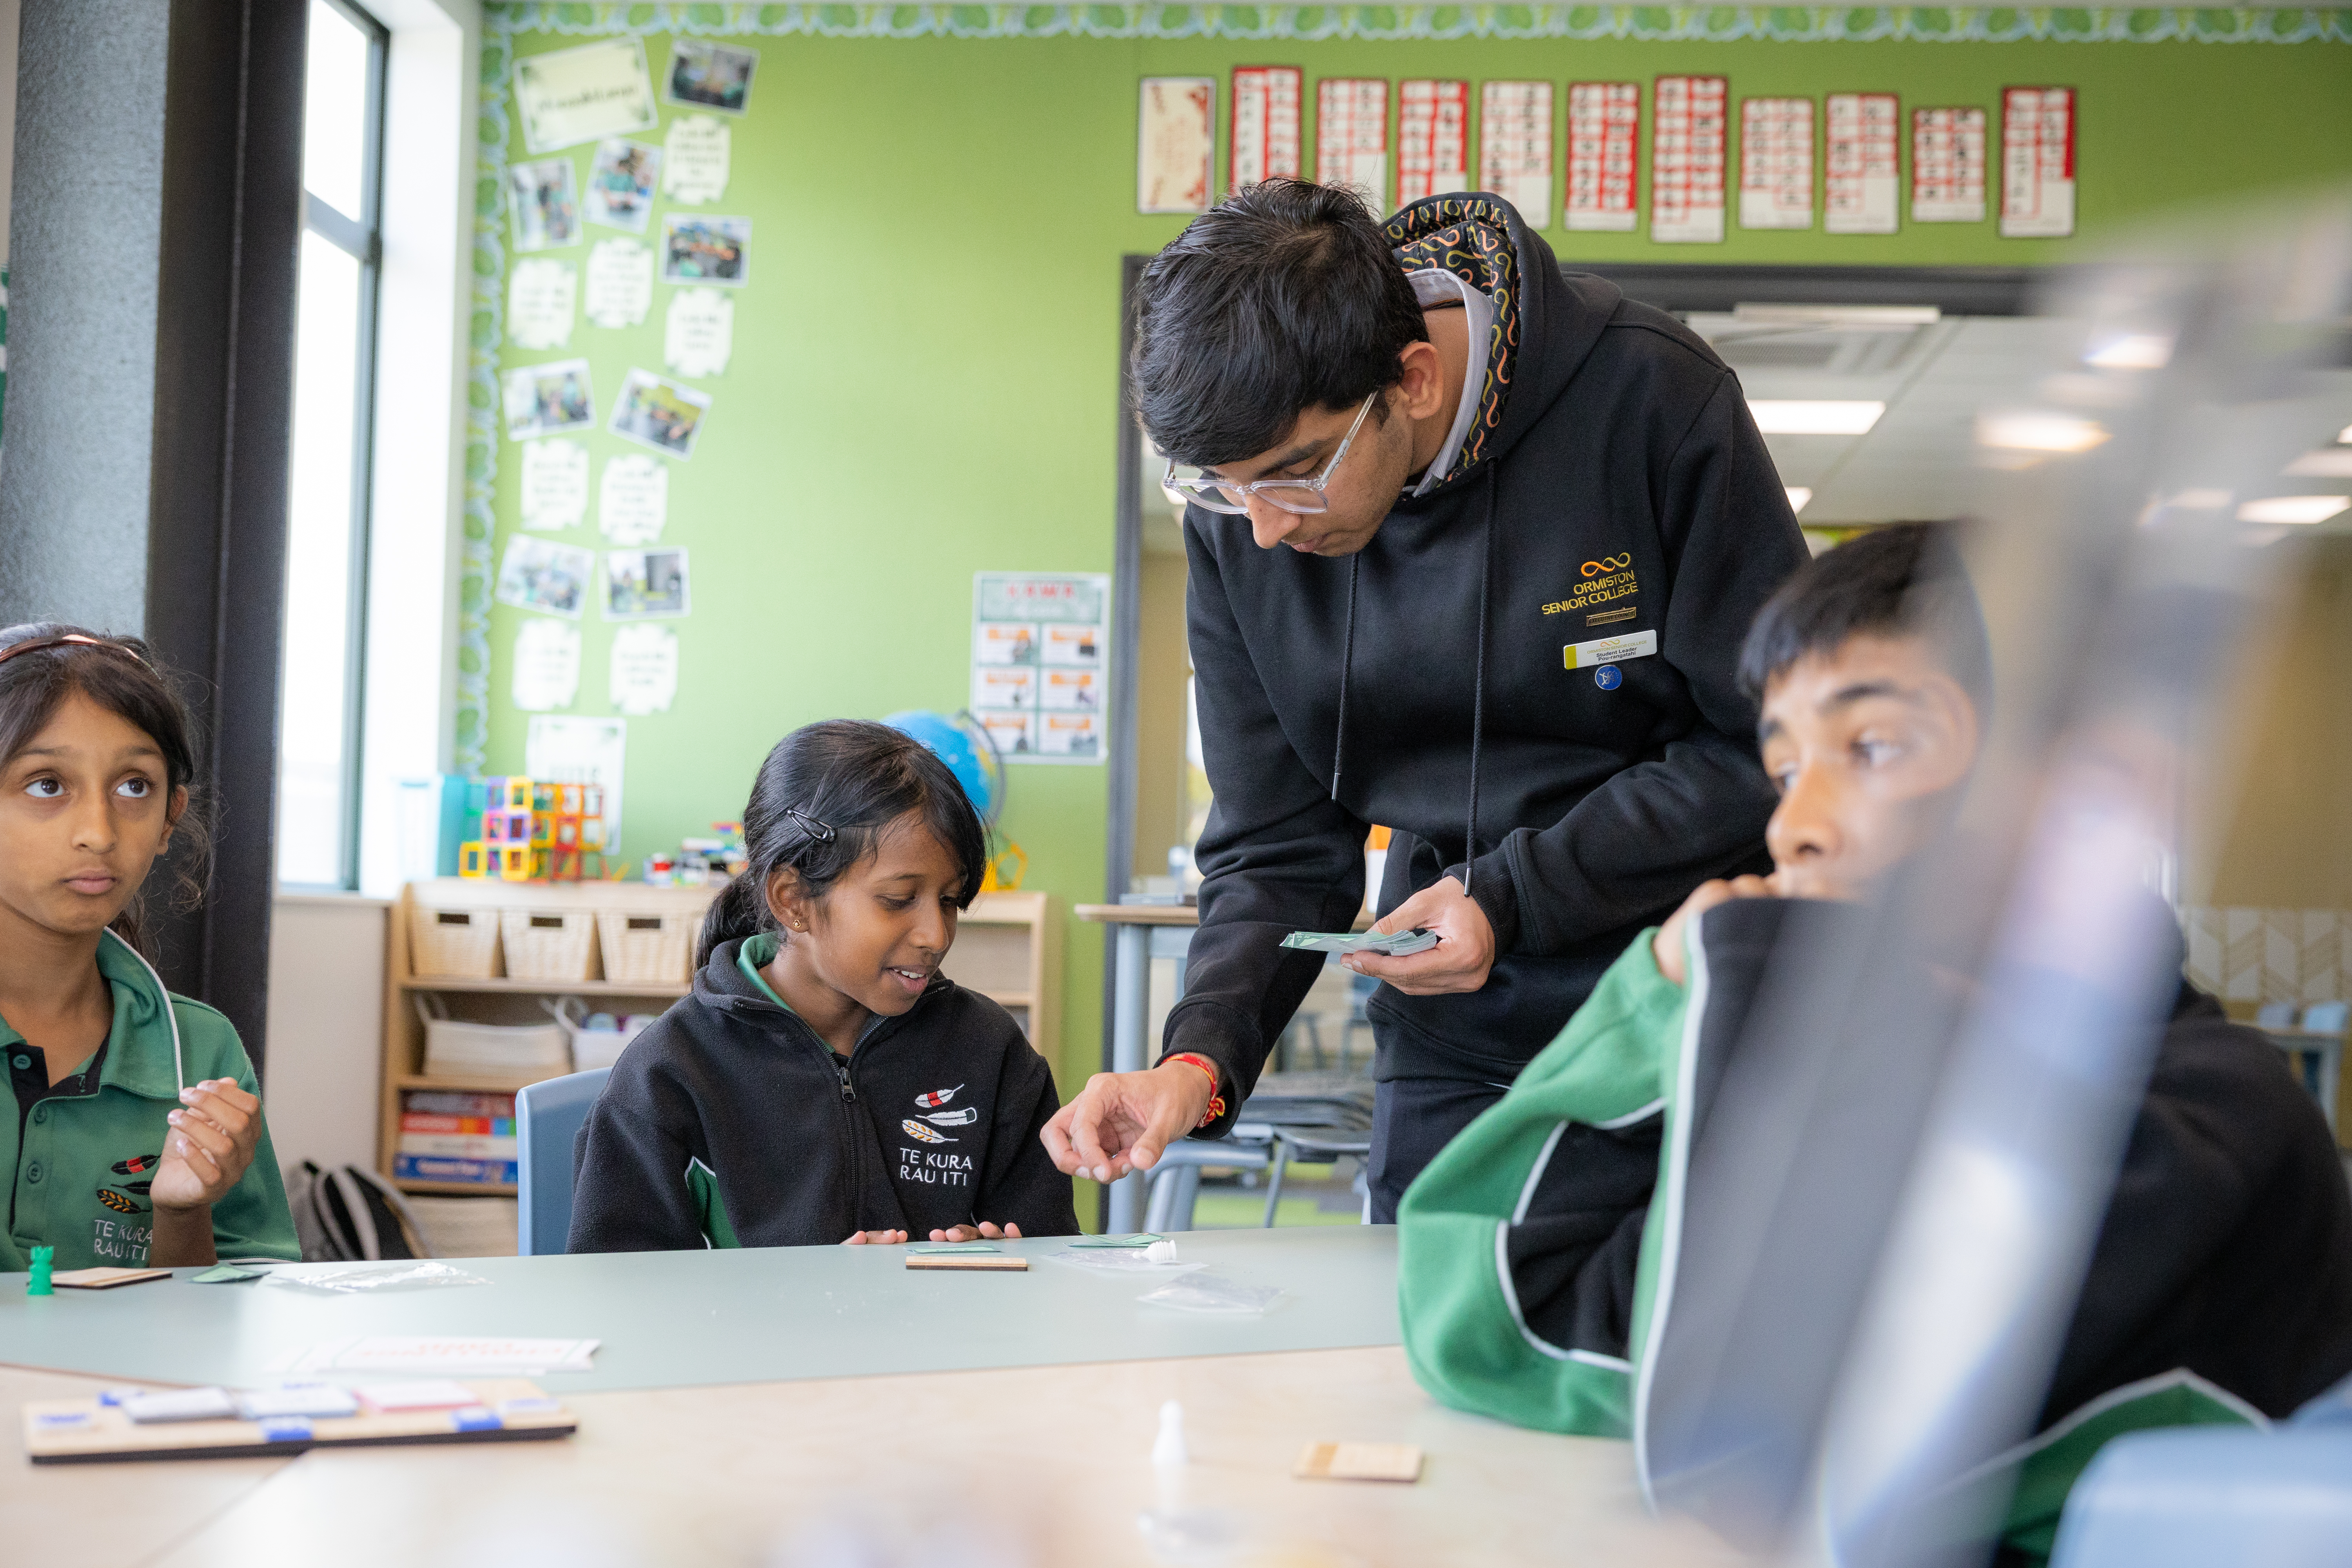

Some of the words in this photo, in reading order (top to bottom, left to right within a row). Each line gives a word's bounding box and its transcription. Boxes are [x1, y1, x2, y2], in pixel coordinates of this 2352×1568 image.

[1573, 570, 1635, 595] ORMISTON
[1542, 597, 1588, 615] SENIOR
[1589, 582, 1638, 603] COLLEGE
[1589, 615, 1613, 623] EXECUTIVE
[1598, 651, 1636, 661] Pou-rangatahi
[900, 1147, 921, 1164] TE
[926, 1152, 973, 1170] KURA
[900, 1165, 936, 1183] RAU
[944, 1171, 967, 1186] ITI
[94, 1219, 115, 1238] TE
[118, 1225, 153, 1244] KURA
[94, 1238, 124, 1258] RAU
[126, 1245, 148, 1261] ITI
